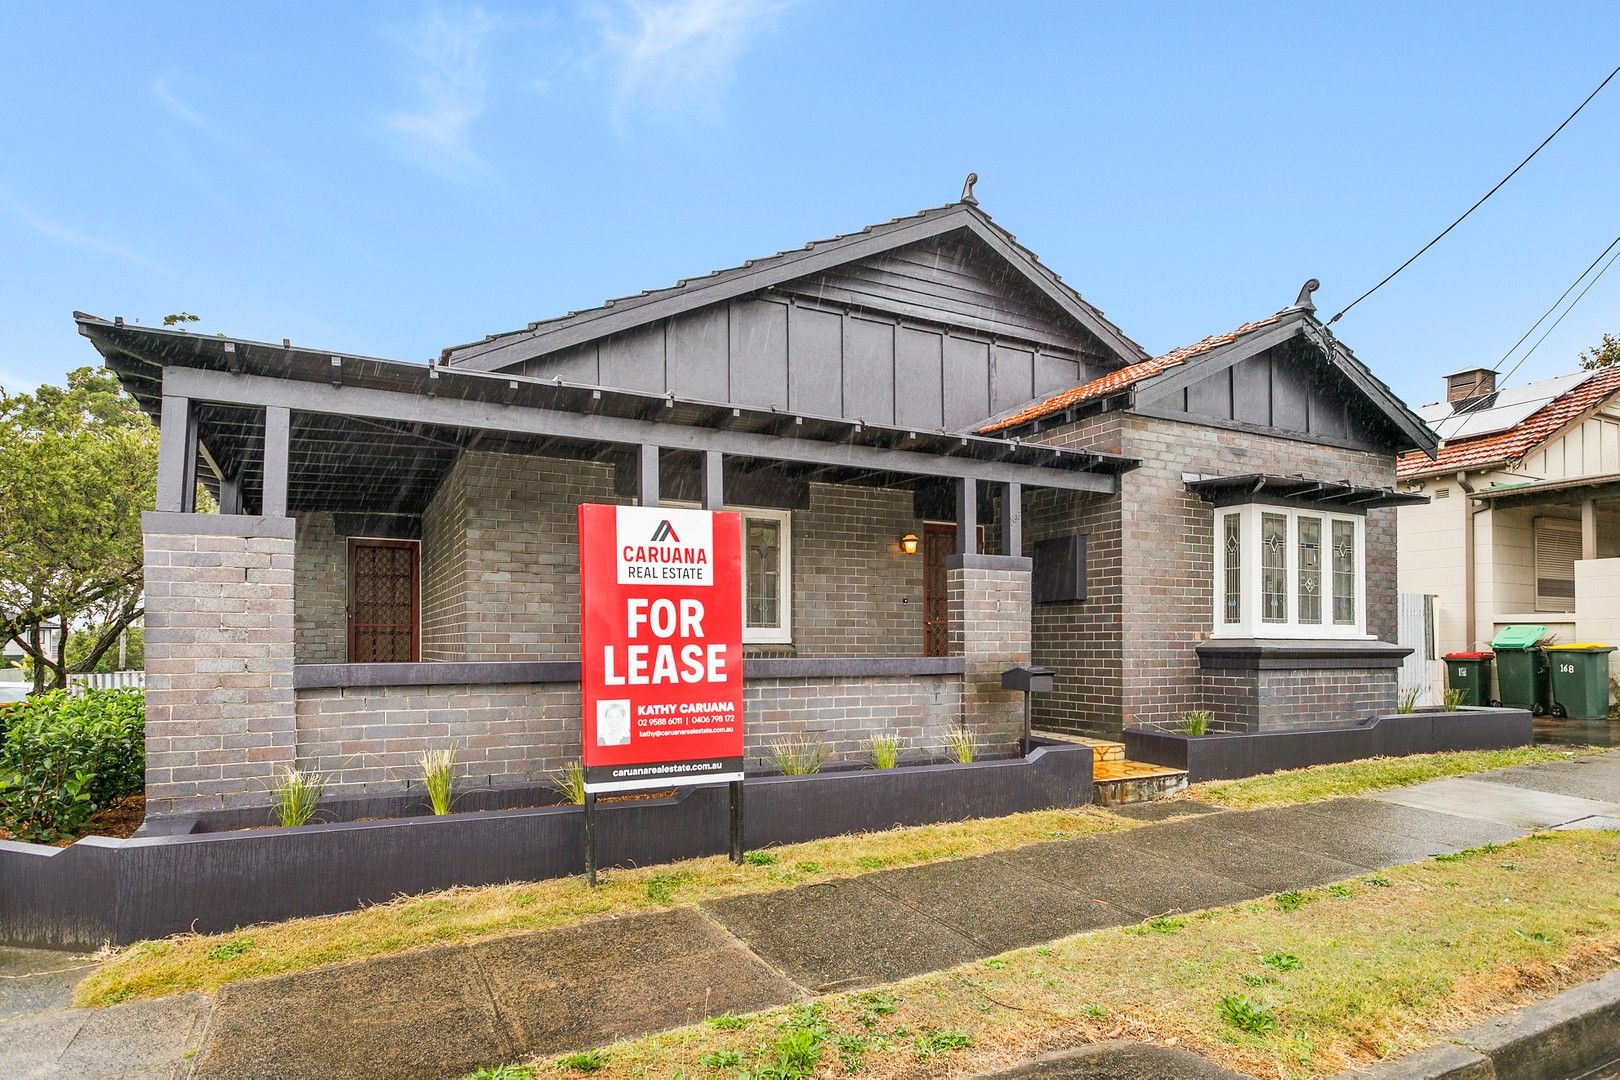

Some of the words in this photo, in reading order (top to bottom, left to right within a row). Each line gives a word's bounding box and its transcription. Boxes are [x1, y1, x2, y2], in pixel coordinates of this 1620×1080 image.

[623, 546, 707, 564] CARUANA
[628, 566, 658, 579] REAL
[662, 567, 703, 580] ESTATE
[627, 598, 704, 638] FOR
[604, 644, 728, 685] LEASE
[1560, 664, 1574, 673] 168
[637, 704, 677, 716] KATHY
[679, 702, 735, 714] CARUANA
[638, 719, 648, 727] 02
[668, 717, 683, 725] 6011
[692, 716, 710, 724] 0406
[639, 728, 734, 737] kathy@caruanarealestate.com.au
[612, 762, 722, 776] caruanarealestate.com.au
